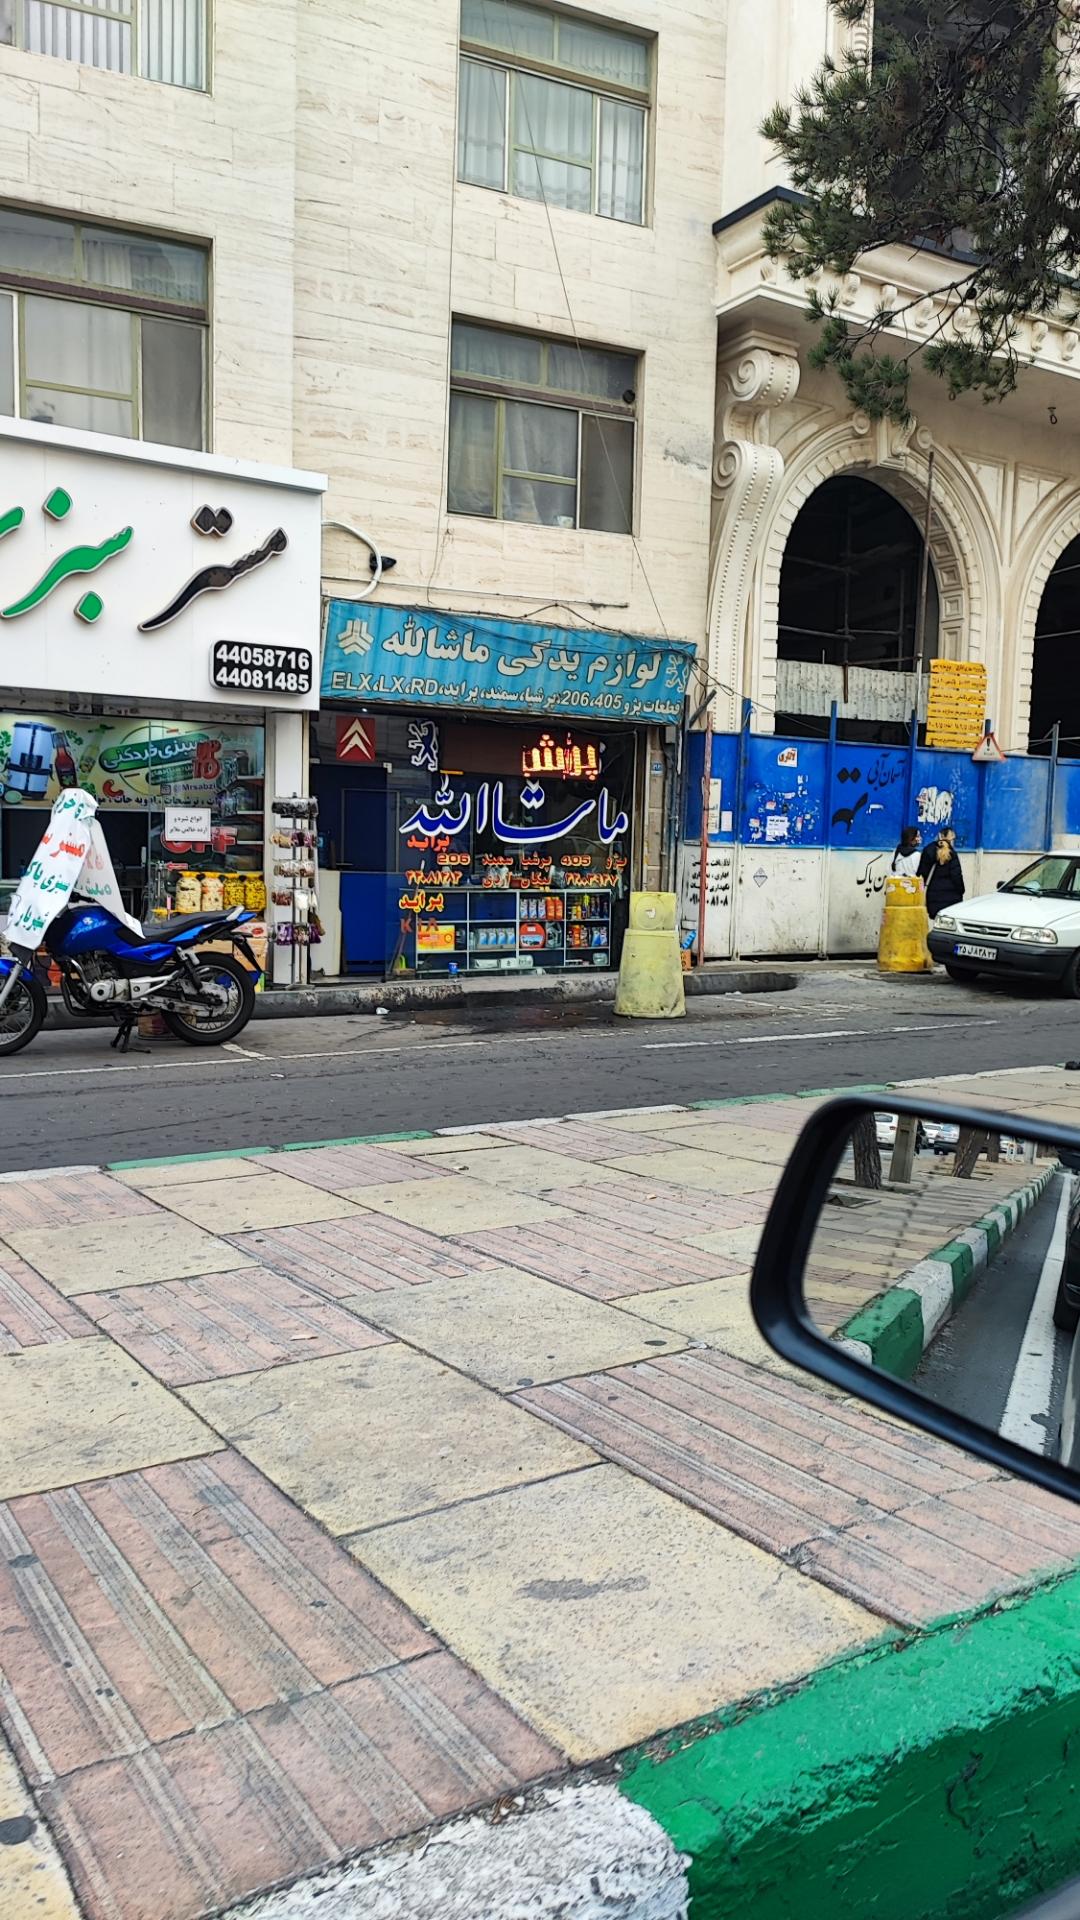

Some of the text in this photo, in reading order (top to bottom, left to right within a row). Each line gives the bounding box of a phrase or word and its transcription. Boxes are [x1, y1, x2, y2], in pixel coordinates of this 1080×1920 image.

[216, 644, 310, 670] 44058716
[586, 649, 663, 688] لوازم
[216, 666, 310, 691] 44081485
[623, 698, 641, 717] پژو
[643, 699, 681, 716] قطعات
[407, 835, 451, 853] پراید
[436, 853, 471, 866] 206
[482, 853, 514, 866] سمند
[560, 855, 592, 866] 405
[856, 854, 883, 898] پاک
[399, 889, 445, 913] پراید
